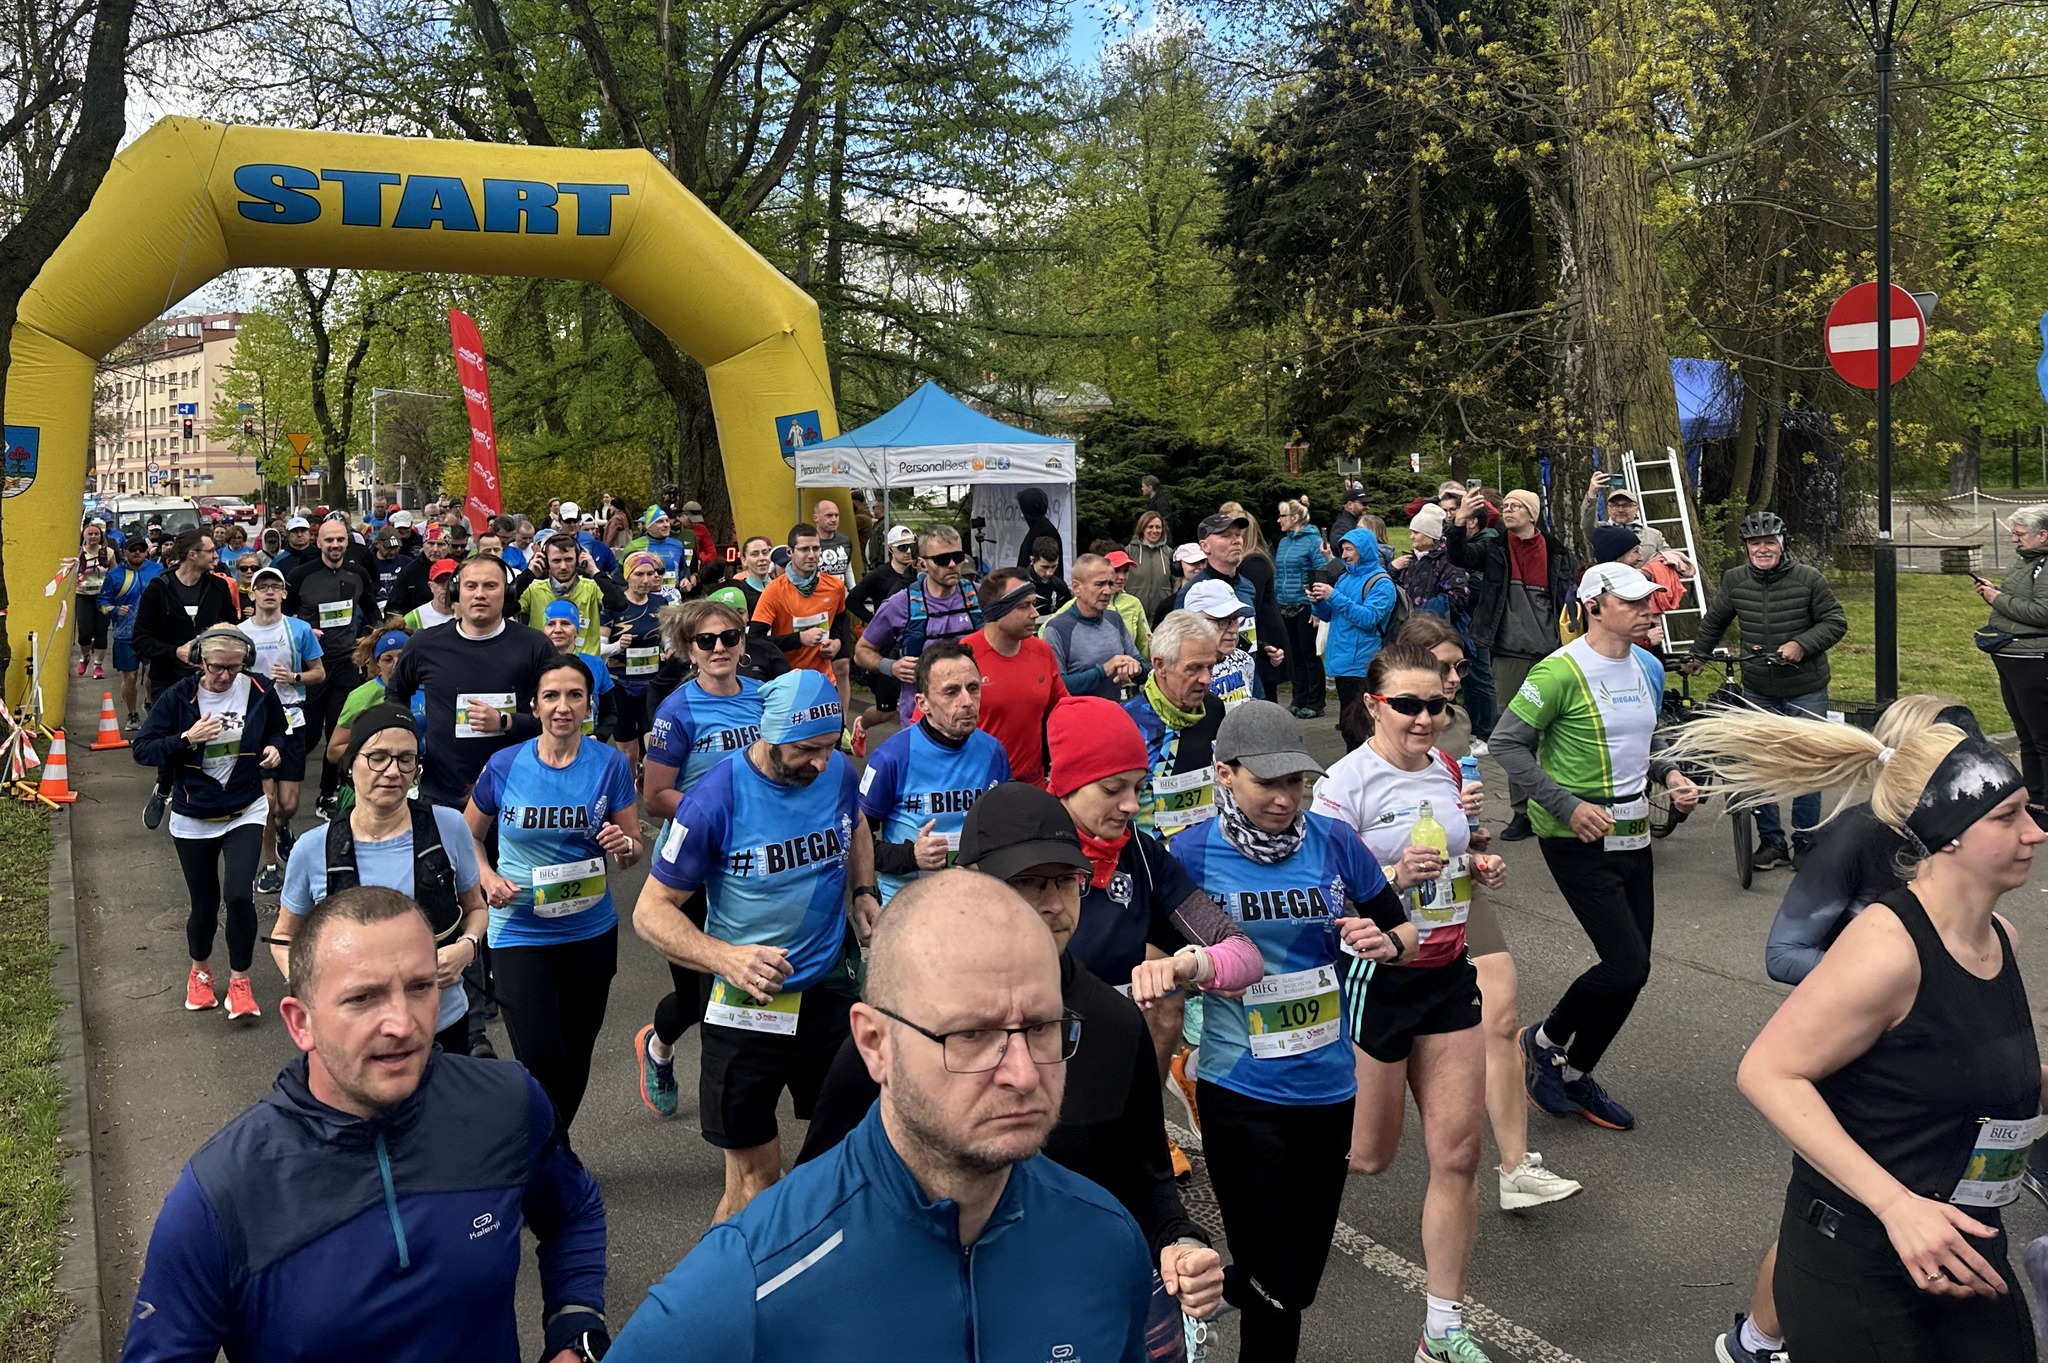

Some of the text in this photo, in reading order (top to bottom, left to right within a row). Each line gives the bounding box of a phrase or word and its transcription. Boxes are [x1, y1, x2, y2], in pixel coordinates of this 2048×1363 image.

[233, 163, 630, 236] START
[900, 459, 968, 473] PersonalBest
[333, 610, 343, 618] 35
[640, 657, 650, 665] 31
[1612, 695, 1640, 704] BIEGAJĄ
[721, 724, 761, 751] BIEG
[222, 744, 230, 754] 1
[1160, 780, 1178, 788] BIEG
[1175, 788, 1202, 809] 237
[522, 805, 590, 829] BIEGA
[1629, 820, 1646, 835] 80
[766, 827, 842, 874] BIEGA
[540, 870, 559, 879] BIEG
[560, 882, 581, 899] 32
[1240, 886, 1330, 922] BIEGA
[1251, 982, 1278, 995] BIEG
[1277, 999, 1320, 1028] 109
[1990, 1127, 2019, 1140] BIEG
